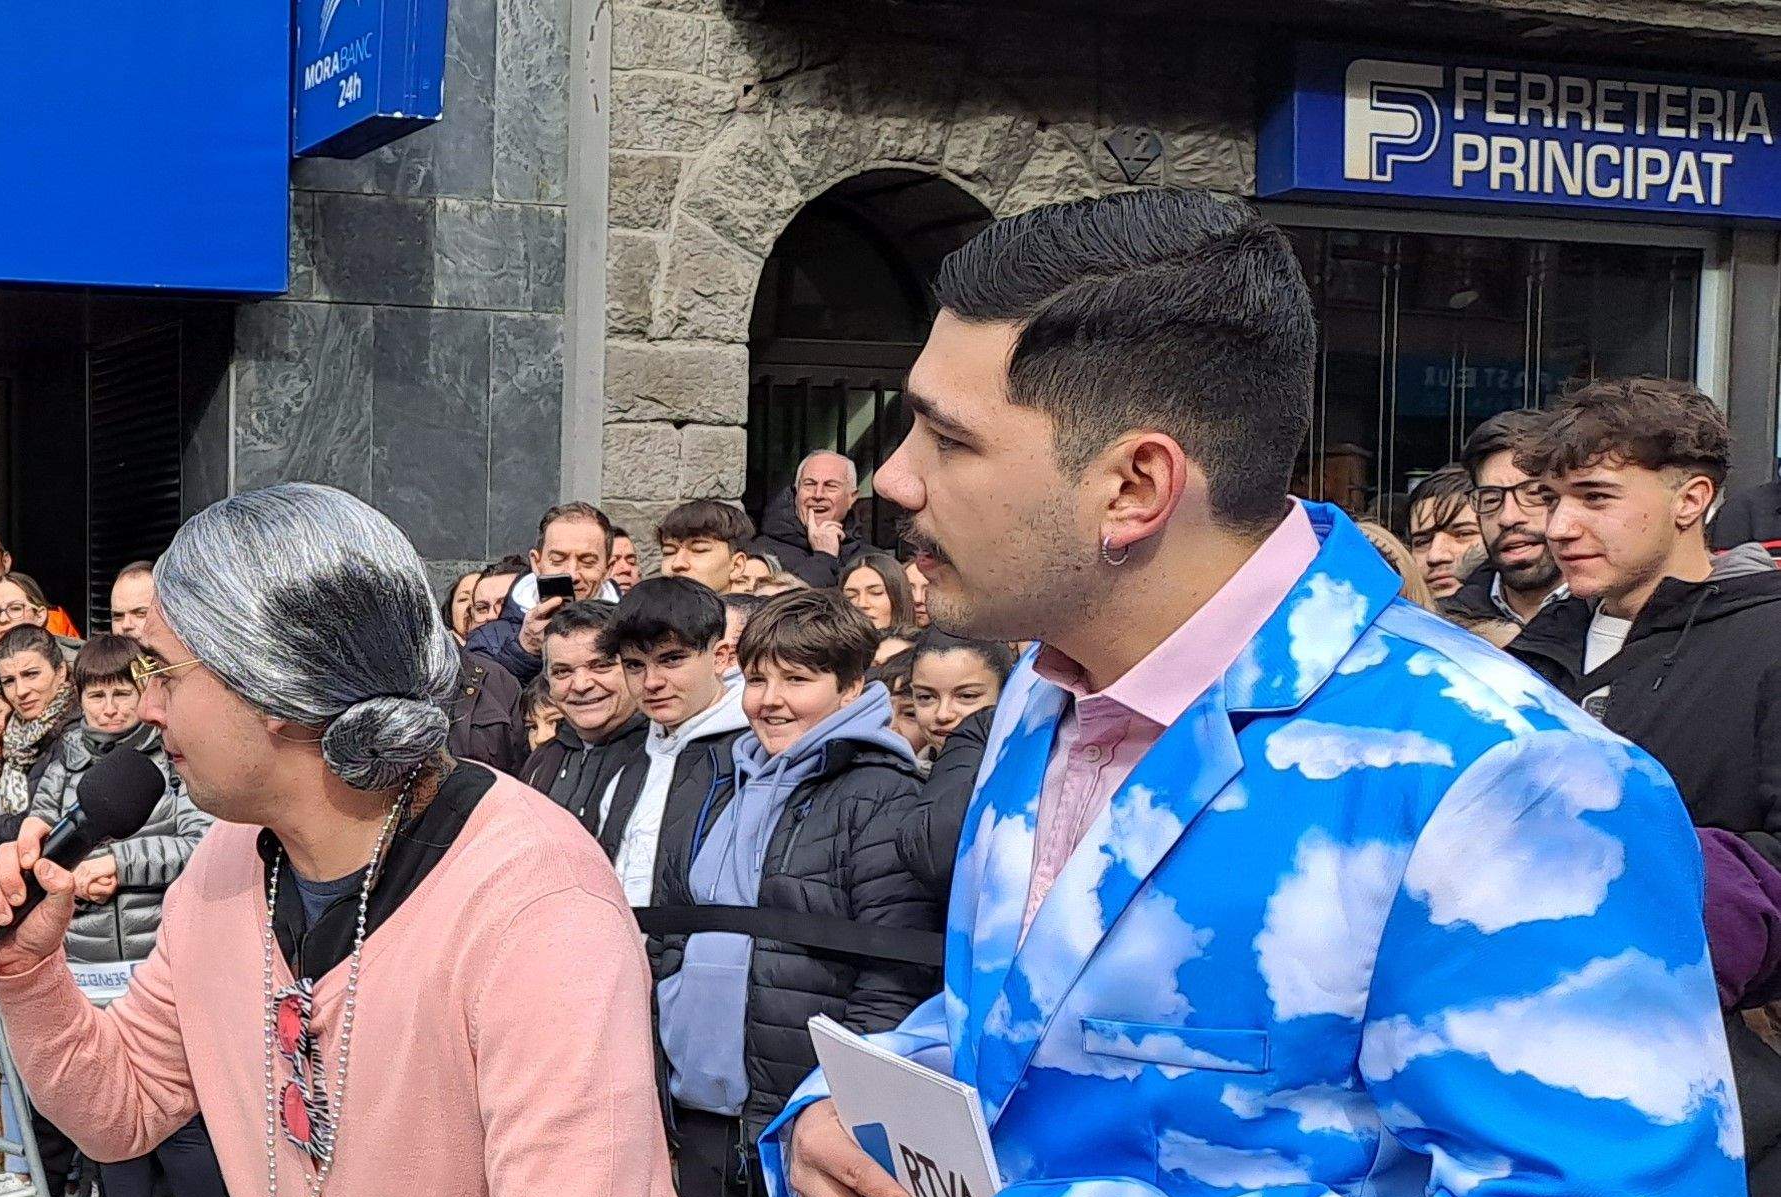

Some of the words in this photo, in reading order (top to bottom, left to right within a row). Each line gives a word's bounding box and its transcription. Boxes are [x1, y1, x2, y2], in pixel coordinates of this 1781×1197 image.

[304, 32, 373, 90] MORABANC
[337, 72, 362, 108] 24h
[1453, 66, 1775, 145] FERRETERIA
[1452, 133, 1735, 206] PRINCIPAT
